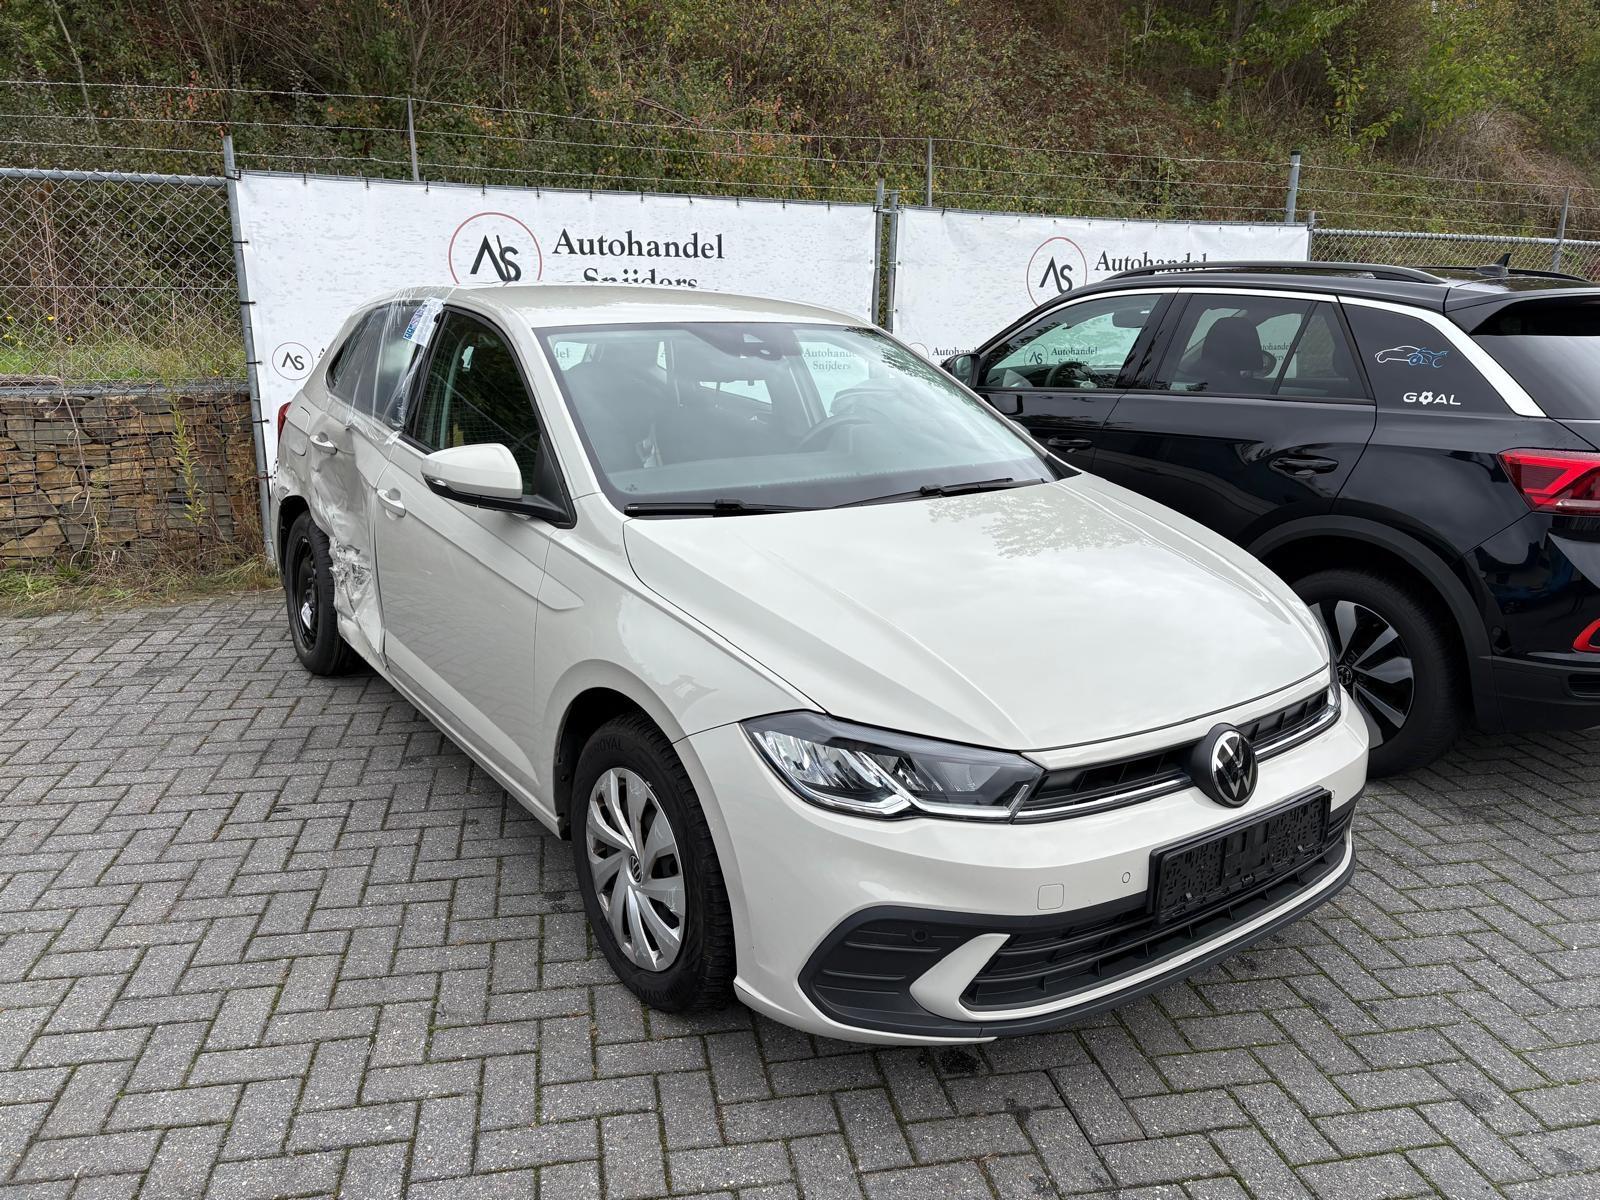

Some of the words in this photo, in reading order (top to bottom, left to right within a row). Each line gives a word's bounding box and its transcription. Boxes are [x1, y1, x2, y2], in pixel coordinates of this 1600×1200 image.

[552, 228, 725, 260] Autohandel
[1051, 346, 1098, 356] Autohandel
[813, 361, 851, 372] Snijders
[1403, 391, 1462, 406] GOAL
